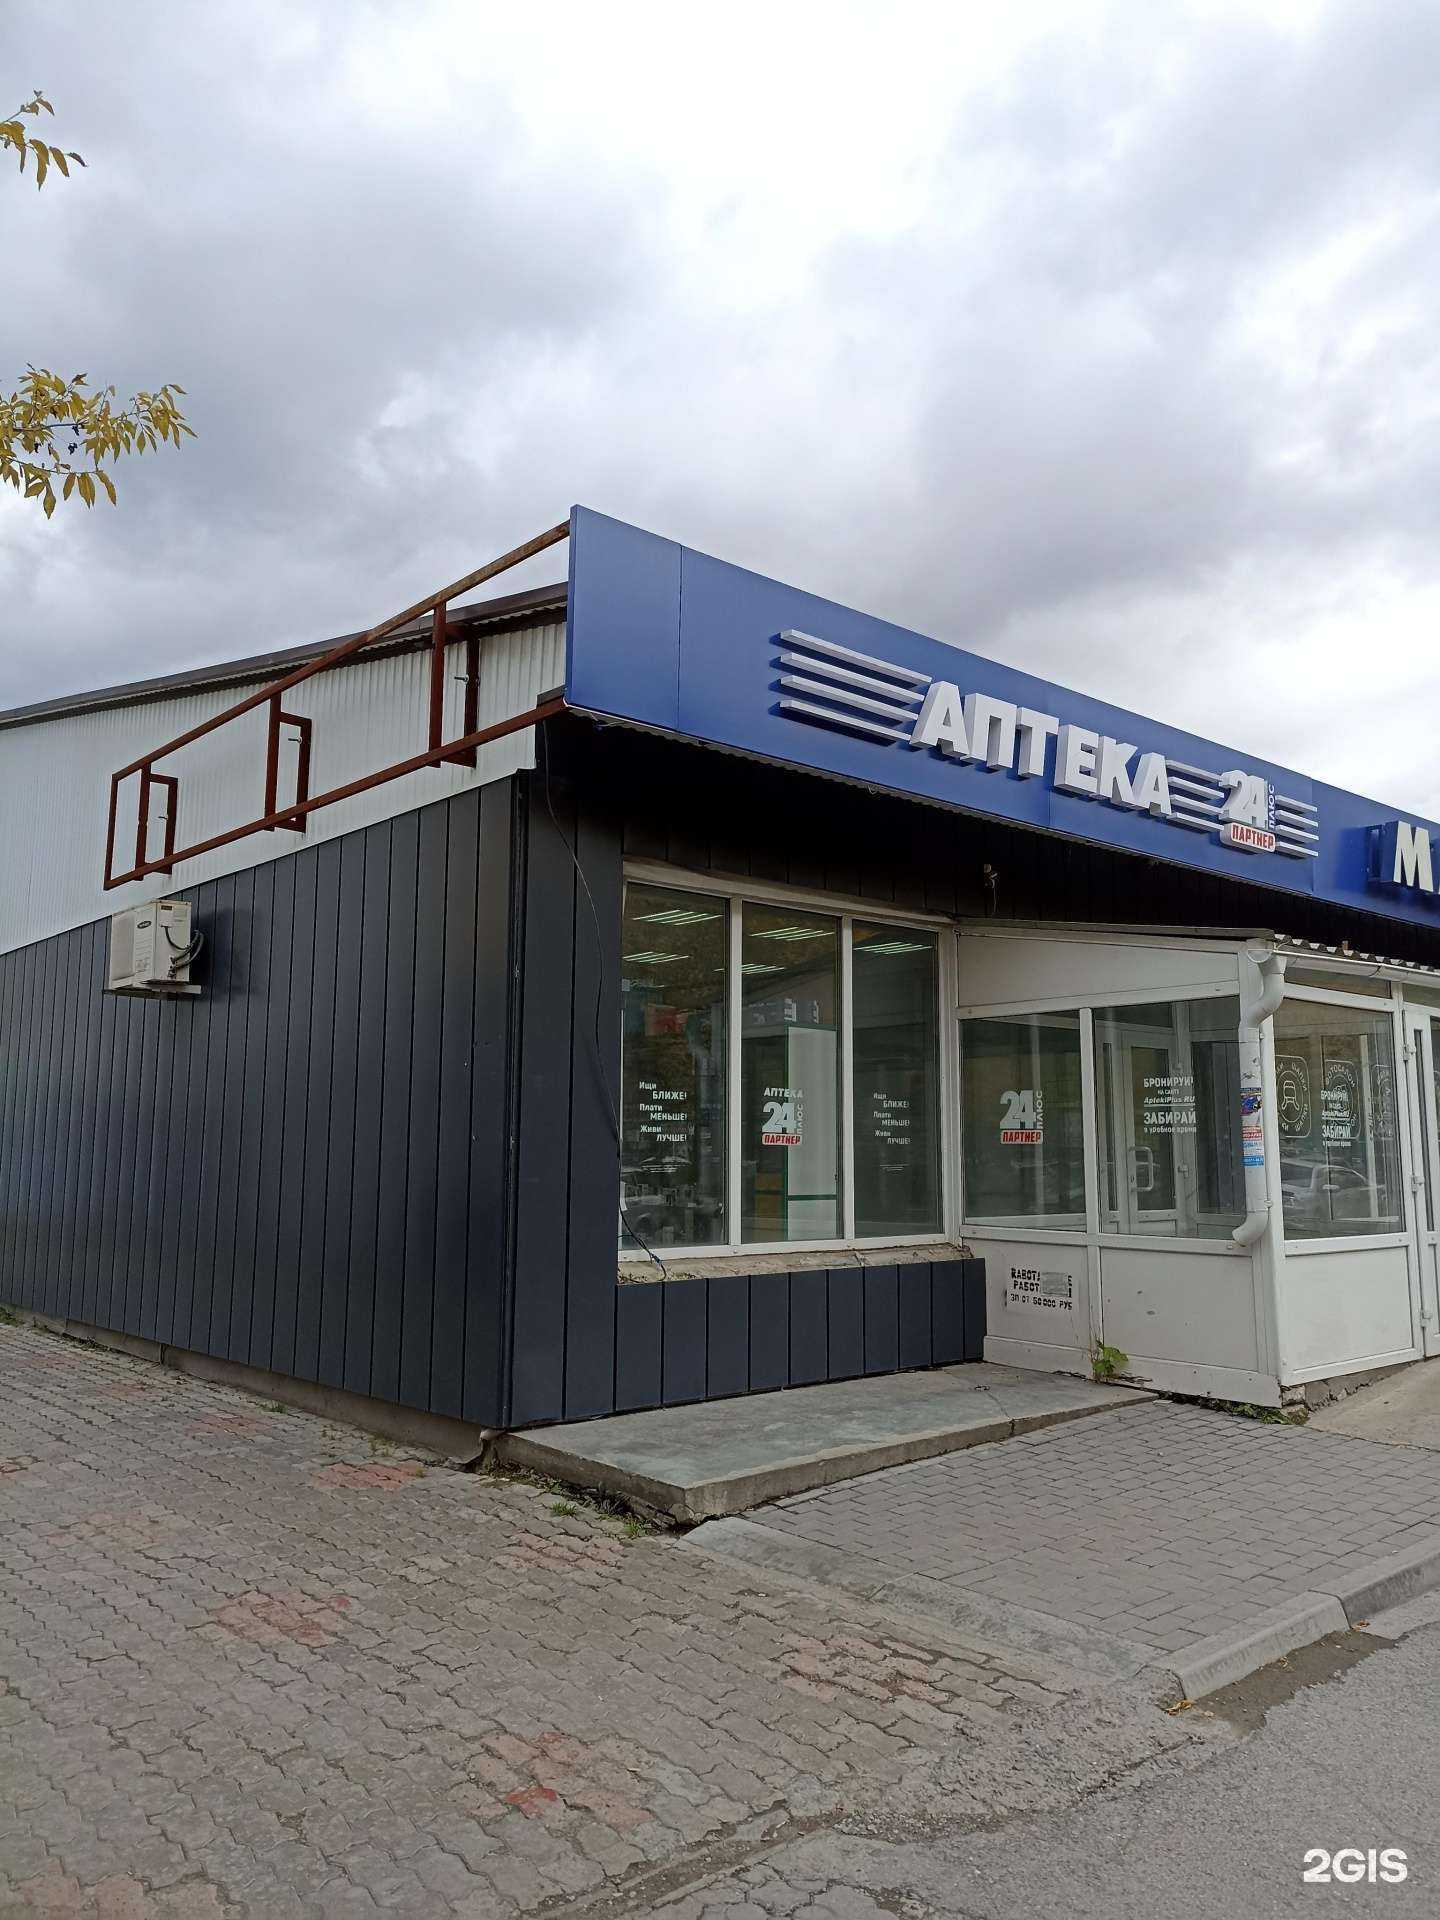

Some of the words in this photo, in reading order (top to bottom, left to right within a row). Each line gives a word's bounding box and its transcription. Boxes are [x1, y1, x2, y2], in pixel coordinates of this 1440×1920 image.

[910, 681, 1172, 817] АПТЕКА
[1220, 770, 1269, 829] 24
[1268, 783, 1276, 830] ПЛЮС
[1231, 823, 1275, 851] ПАРТНЕР
[1392, 820, 1440, 895] М
[639, 1081, 657, 1090] Ищи
[763, 1087, 804, 1098] АПТЕКА
[652, 1090, 687, 1100] БЛИЖЕ!
[639, 1103, 663, 1112] Плати
[1000, 1090, 1036, 1129] 24
[1036, 1090, 1044, 1129] ПЛЮС
[650, 1112, 688, 1121] МЕНЬШЕ!
[761, 1101, 795, 1133] 24
[796, 1103, 804, 1134] ПЛЮС
[1143, 1108, 1197, 1125] ЗАБИРАЙ
[640, 1124, 662, 1133] Живи
[656, 1133, 687, 1142] ЛУЧШЕ!
[764, 1134, 801, 1145] ПАРТНЕР
[1002, 1131, 1042, 1143] ПАРТНЕР
